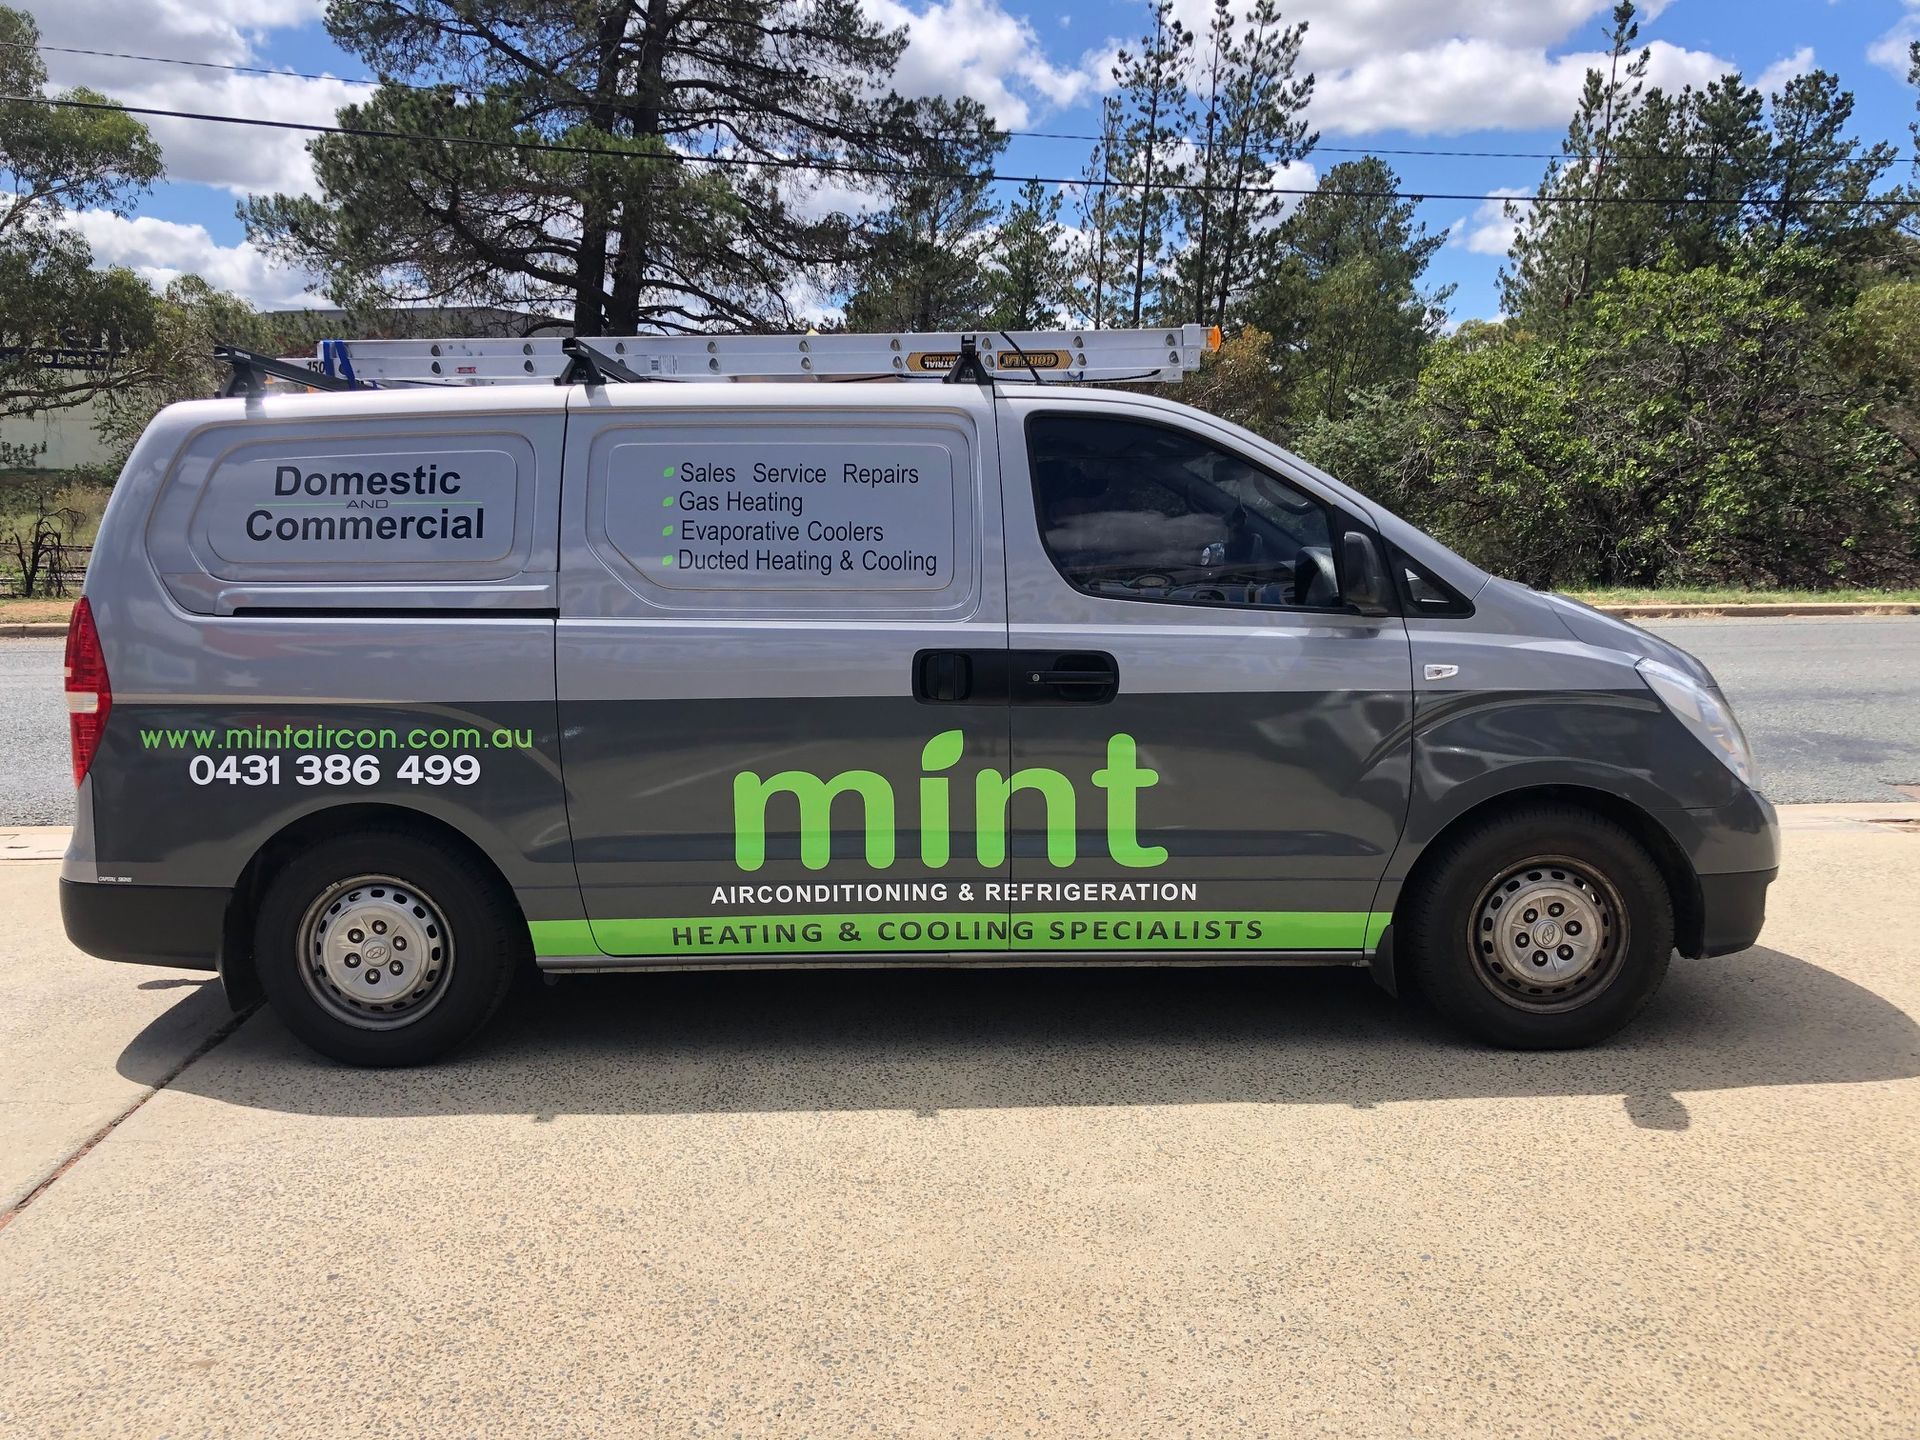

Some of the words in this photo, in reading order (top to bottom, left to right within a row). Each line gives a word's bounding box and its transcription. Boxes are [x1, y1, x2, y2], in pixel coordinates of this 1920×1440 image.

[924, 361, 955, 369] STRIAL
[1002, 354, 1057, 367] GORLA
[275, 464, 462, 496] Domestic
[680, 462, 736, 483] Sales
[752, 462, 827, 484] Service
[843, 463, 919, 489] Repairs
[346, 499, 389, 509] AND
[679, 490, 719, 512] Gas
[727, 490, 803, 517] Heating
[246, 507, 484, 542] Commercial
[681, 519, 800, 546] Evaporative
[807, 520, 884, 542] Coolers
[678, 548, 749, 570] Ducted
[756, 549, 832, 576] Heating
[839, 549, 854, 571] &
[862, 549, 937, 577] Cooling
[139, 724, 534, 750] www.mintaircon.com.au
[189, 754, 280, 786] 0431
[295, 754, 381, 786] 386
[396, 754, 481, 786] 499
[733, 729, 1169, 872] mint
[711, 883, 948, 905] AIRCONDITIONING
[958, 883, 975, 902] &
[985, 883, 1198, 902] REFRIGERATION
[672, 923, 823, 946] HEATING
[838, 921, 862, 942] &
[877, 920, 1035, 943] COOLING
[1049, 919, 1264, 941] SPECIALISTS
